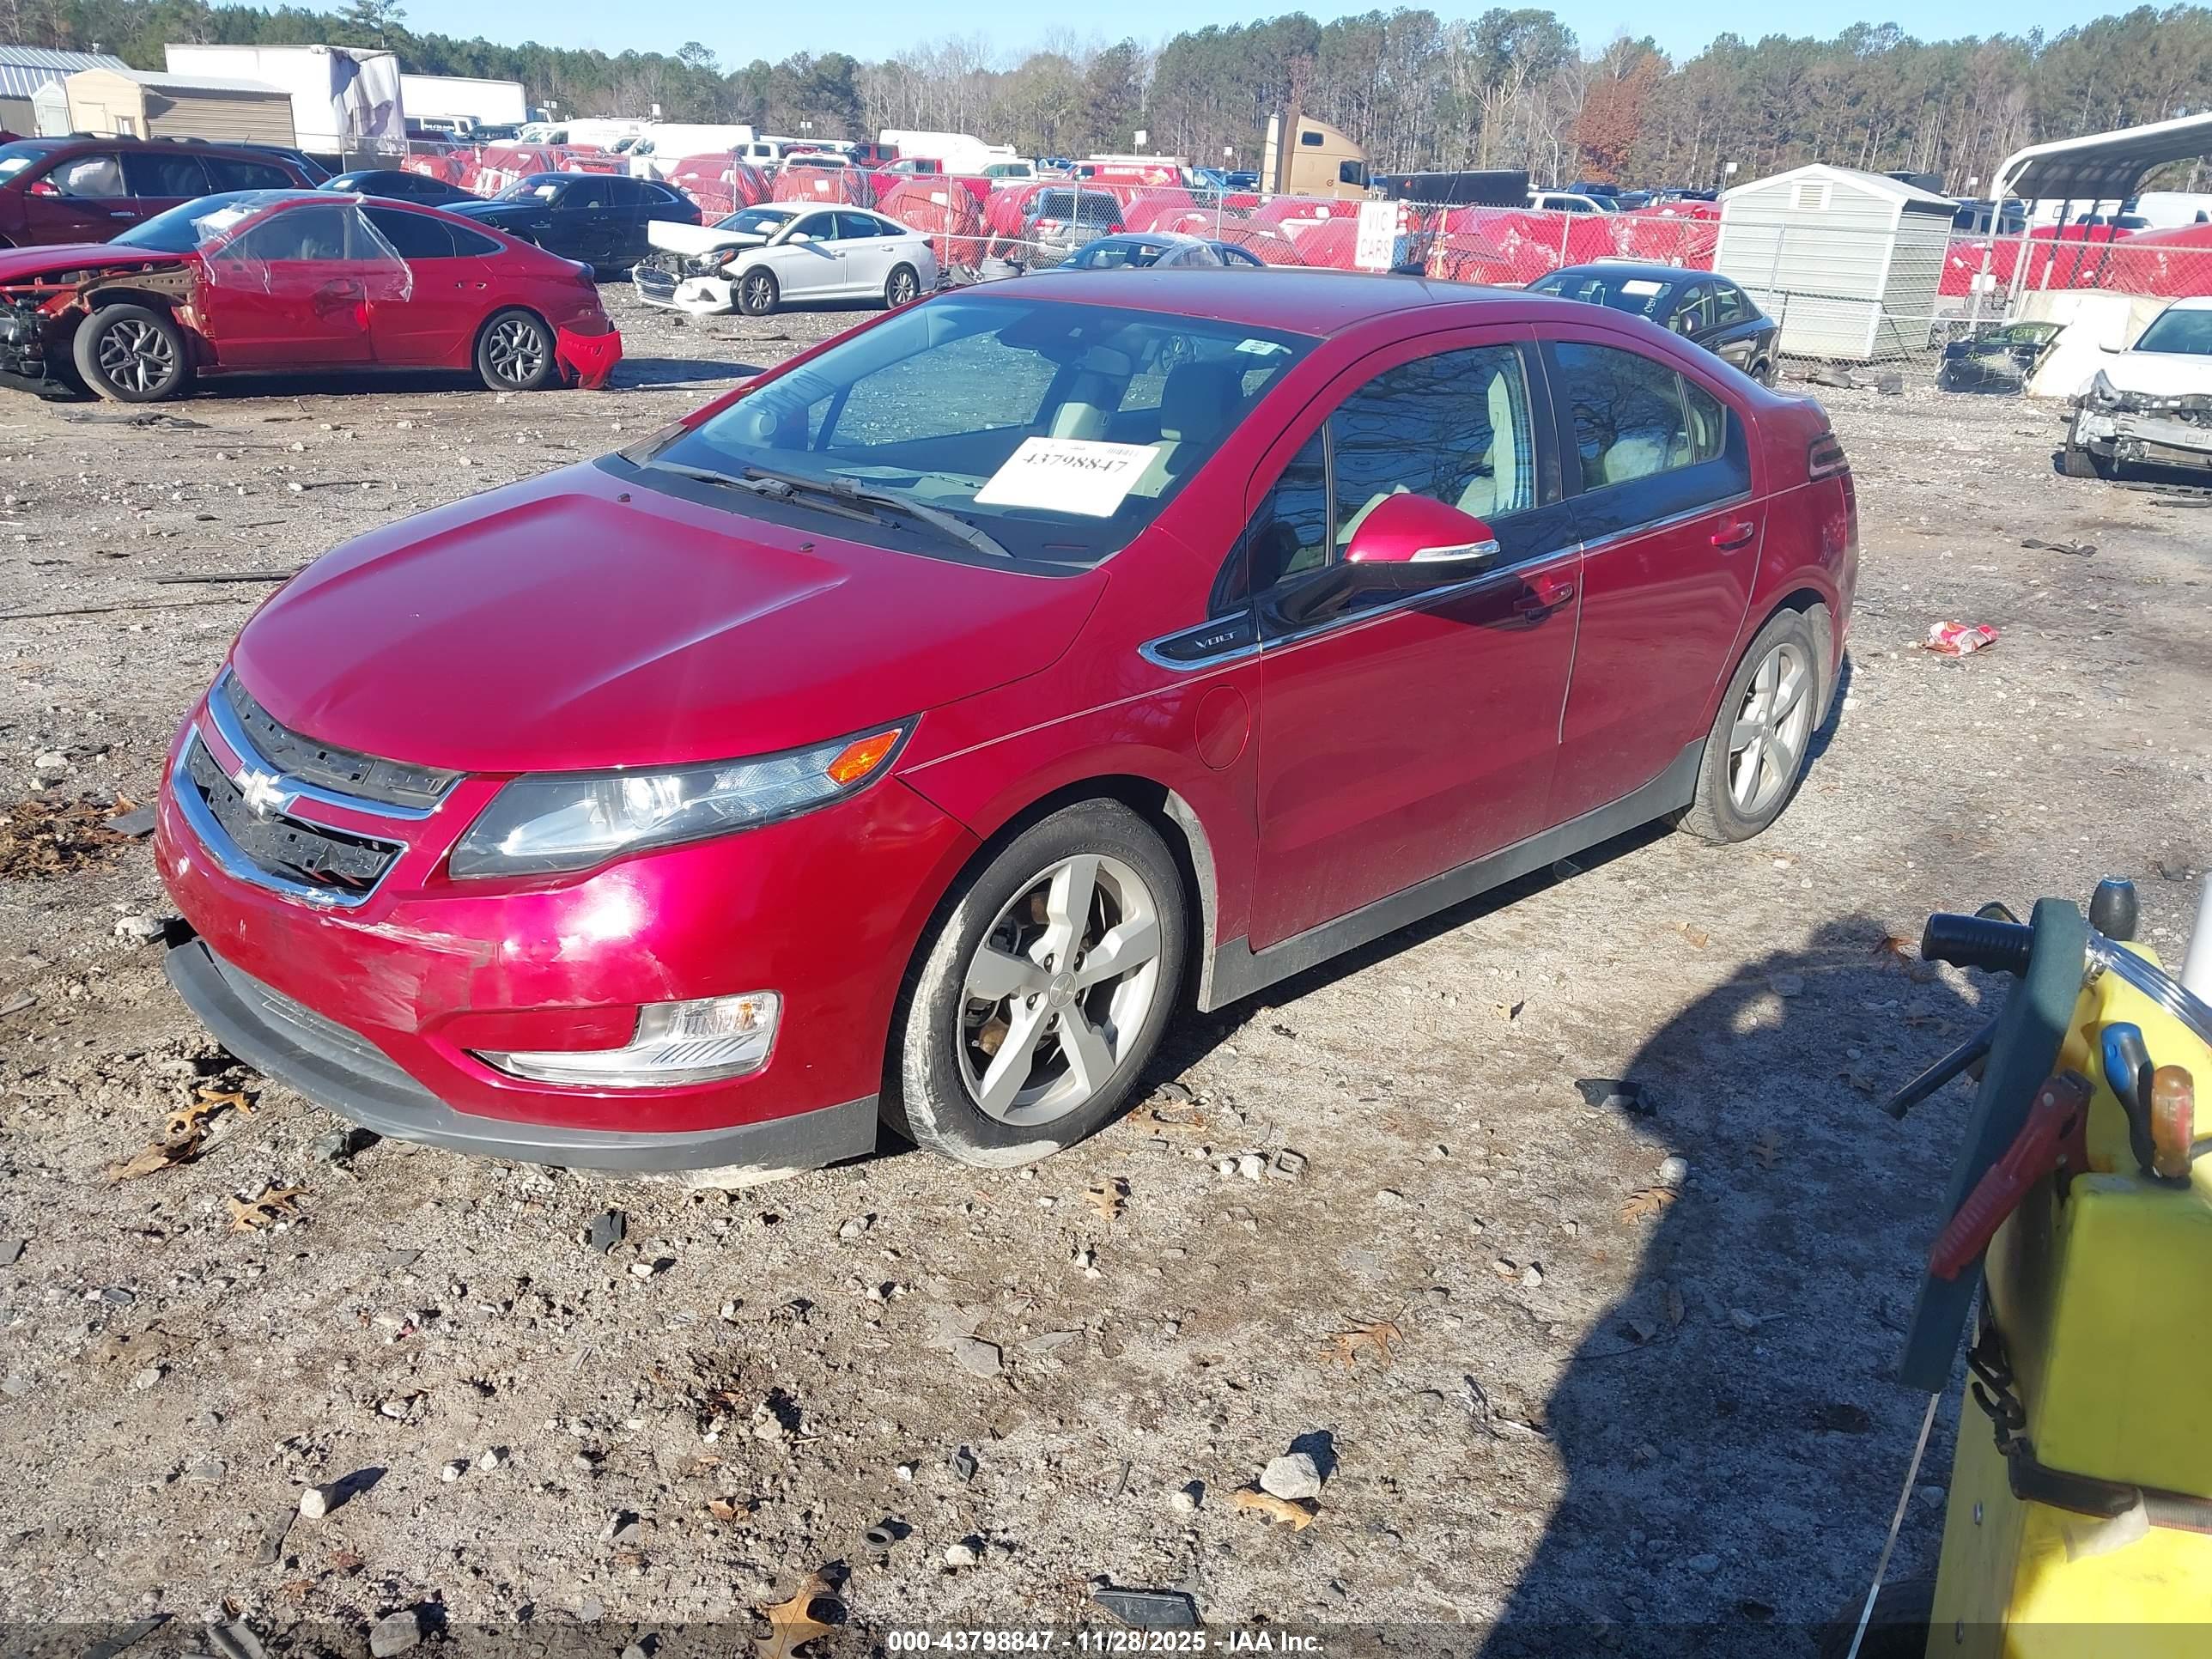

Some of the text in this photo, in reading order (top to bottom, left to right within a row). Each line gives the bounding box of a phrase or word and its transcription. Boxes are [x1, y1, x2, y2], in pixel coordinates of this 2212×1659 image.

[1360, 239, 1390, 260] CARS
[1023, 453, 1128, 473] 43798847
[1195, 631, 1237, 648] VOLT
